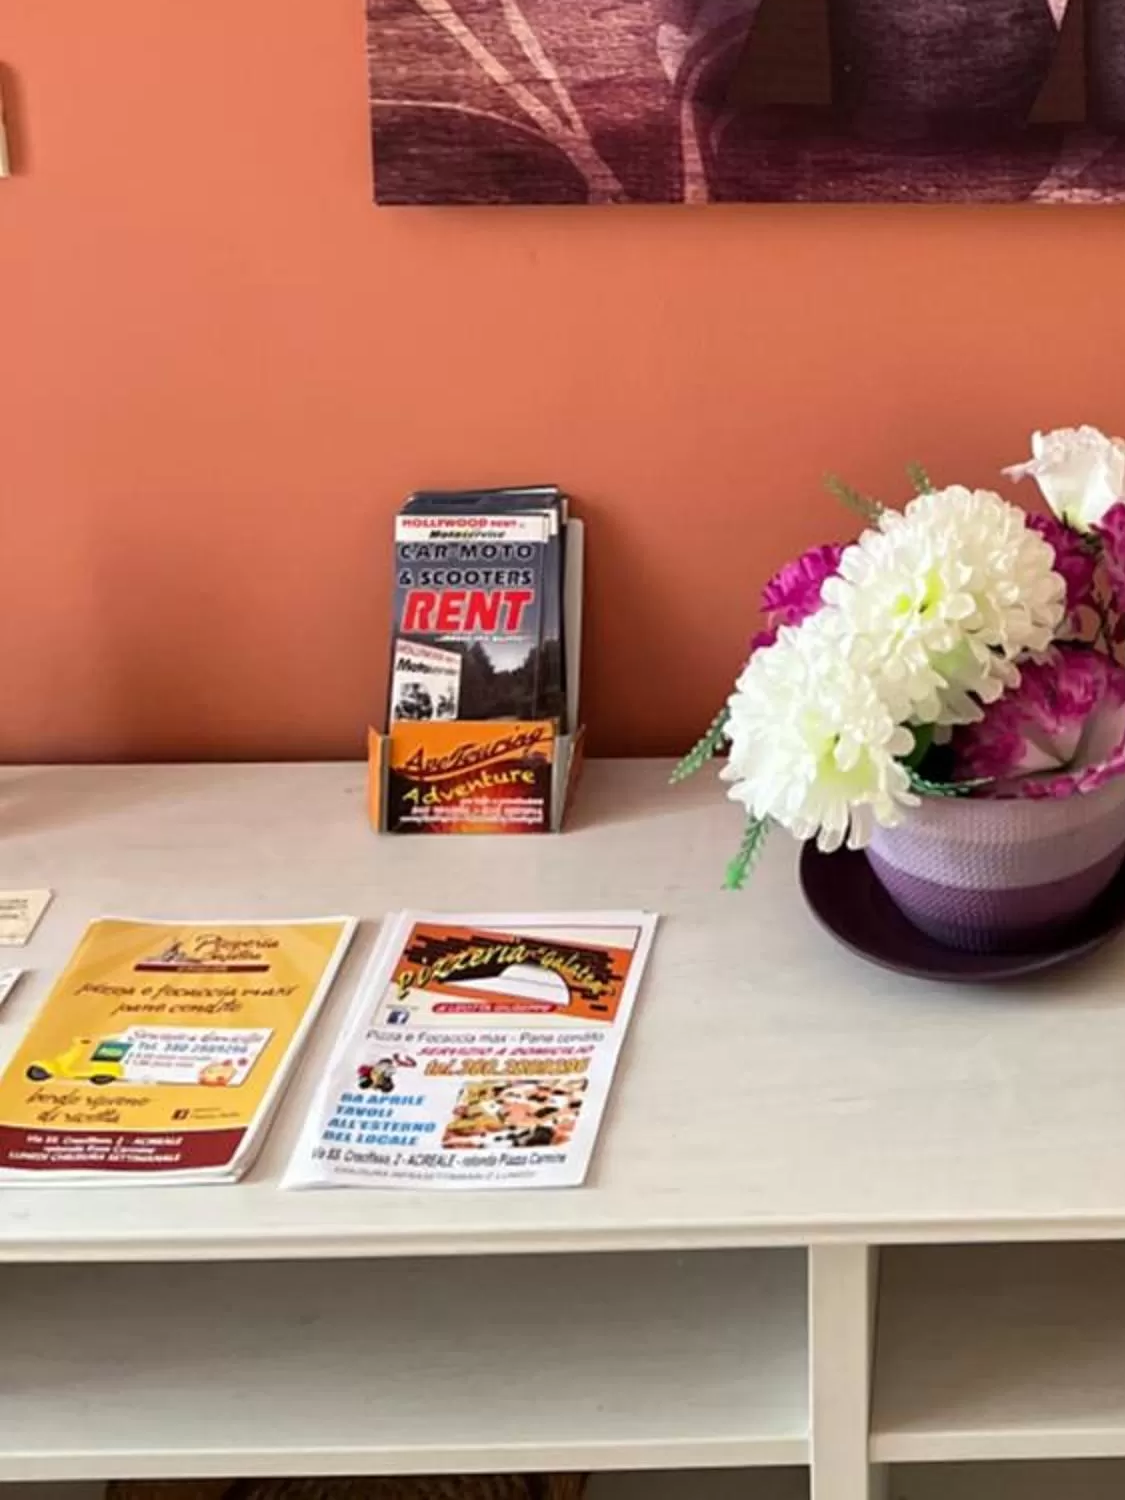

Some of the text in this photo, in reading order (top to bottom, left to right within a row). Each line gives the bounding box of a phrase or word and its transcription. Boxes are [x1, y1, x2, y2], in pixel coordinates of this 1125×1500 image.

[402, 518, 488, 529] HOLLYWOOD
[401, 545, 533, 560] CAR MOTO
[400, 571, 533, 586] & SCOOTERS
[402, 590, 535, 633] RENT
[402, 769, 536, 806] Adventure
[396, 942, 529, 1001] Pizzeria
[417, 1032, 476, 1043] Focaccia
[519, 1032, 553, 1043] Pane
[366, 1094, 425, 1106] APRILE
[336, 1105, 393, 1118] TAVOLI
[322, 1129, 418, 1145] DEL LOCALE
